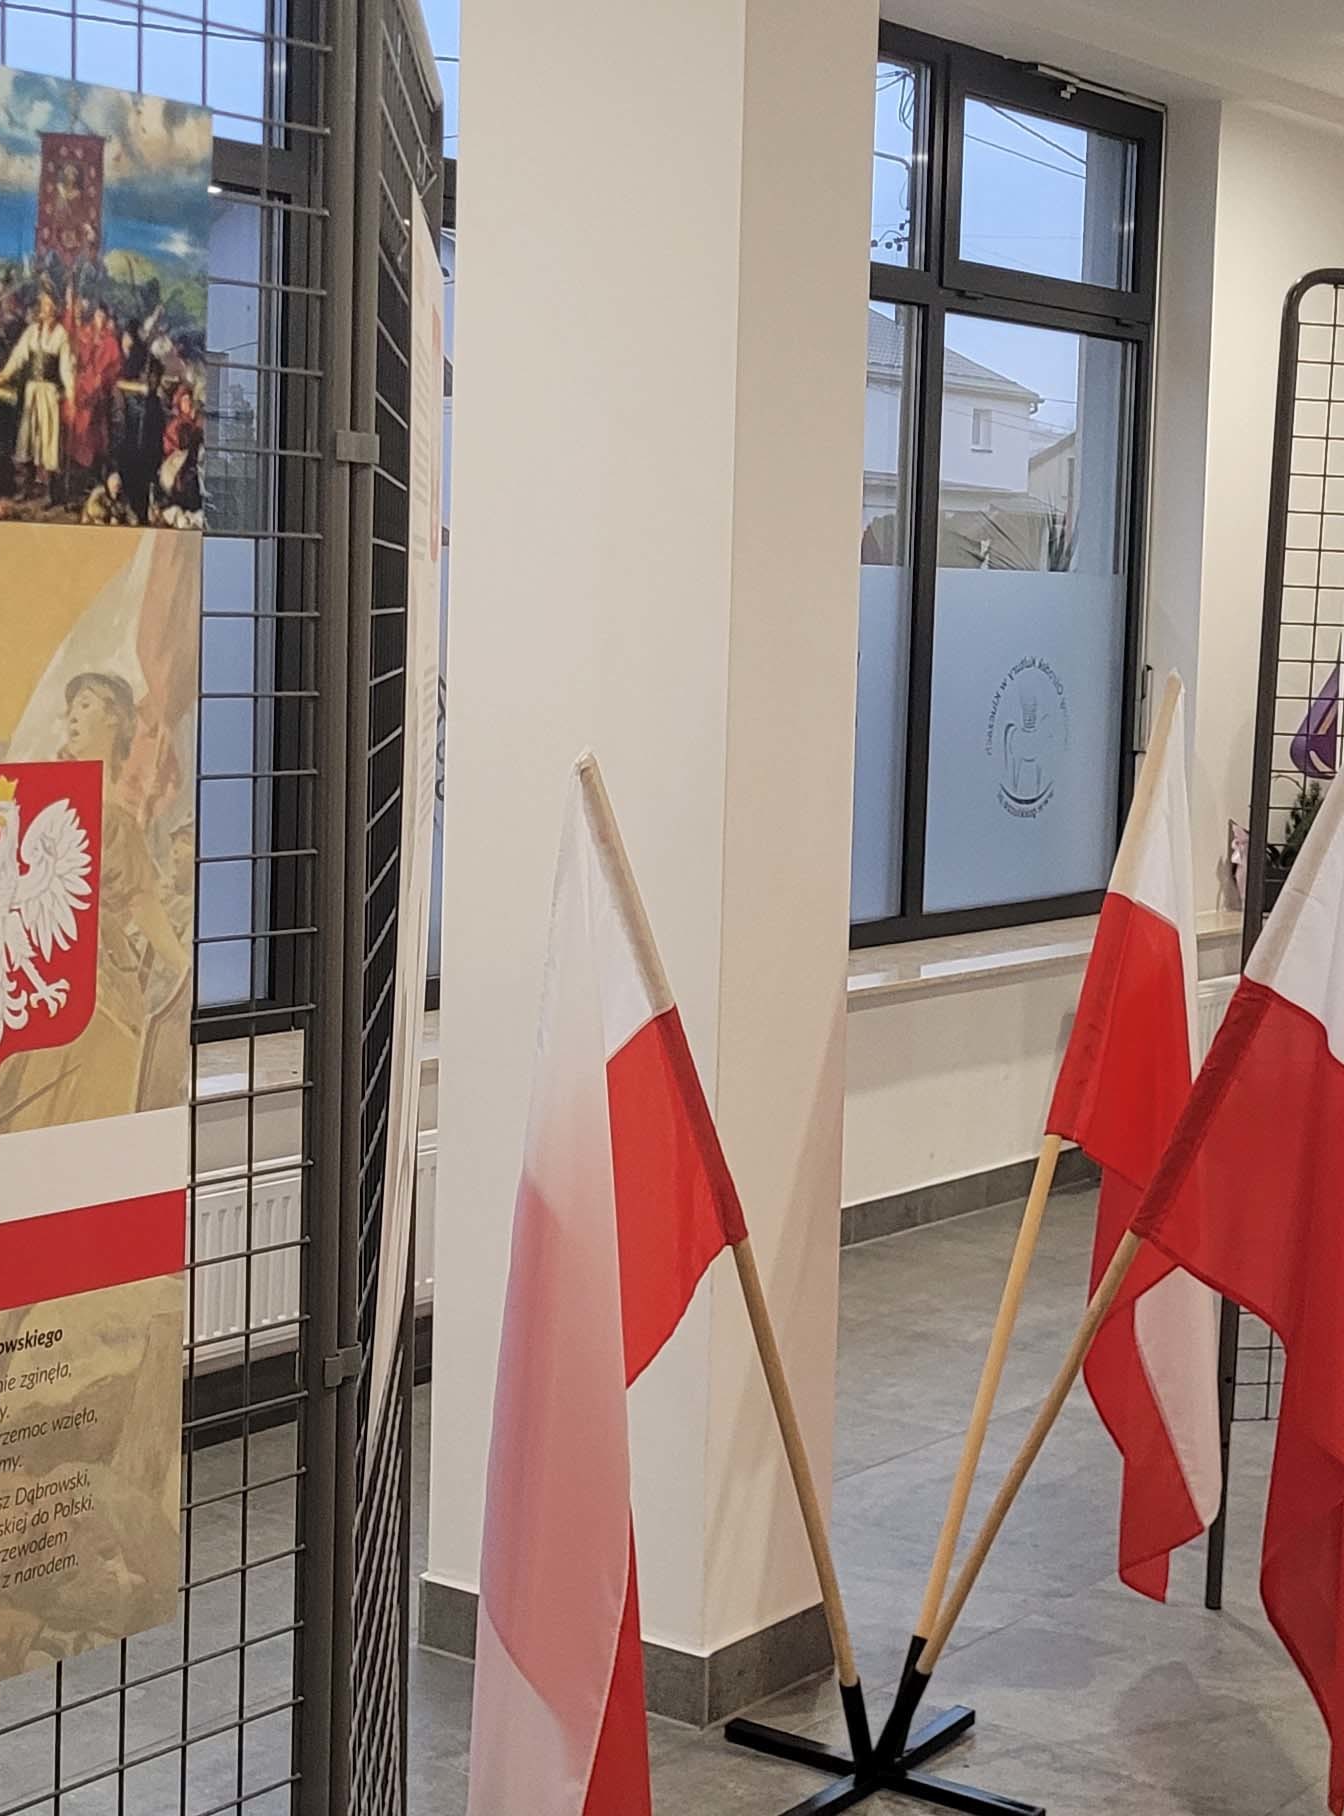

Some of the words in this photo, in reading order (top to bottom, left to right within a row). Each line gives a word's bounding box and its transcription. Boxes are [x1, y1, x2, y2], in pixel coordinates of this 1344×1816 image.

[20, 1363, 71, 1392] zginęła,
[51, 1409, 97, 1434] wzięła,
[15, 1470, 90, 1510] Dąbrowski,
[31, 1509, 48, 1529] do
[53, 1495, 94, 1522] Polski.
[14, 1557, 78, 1587] narodem.
